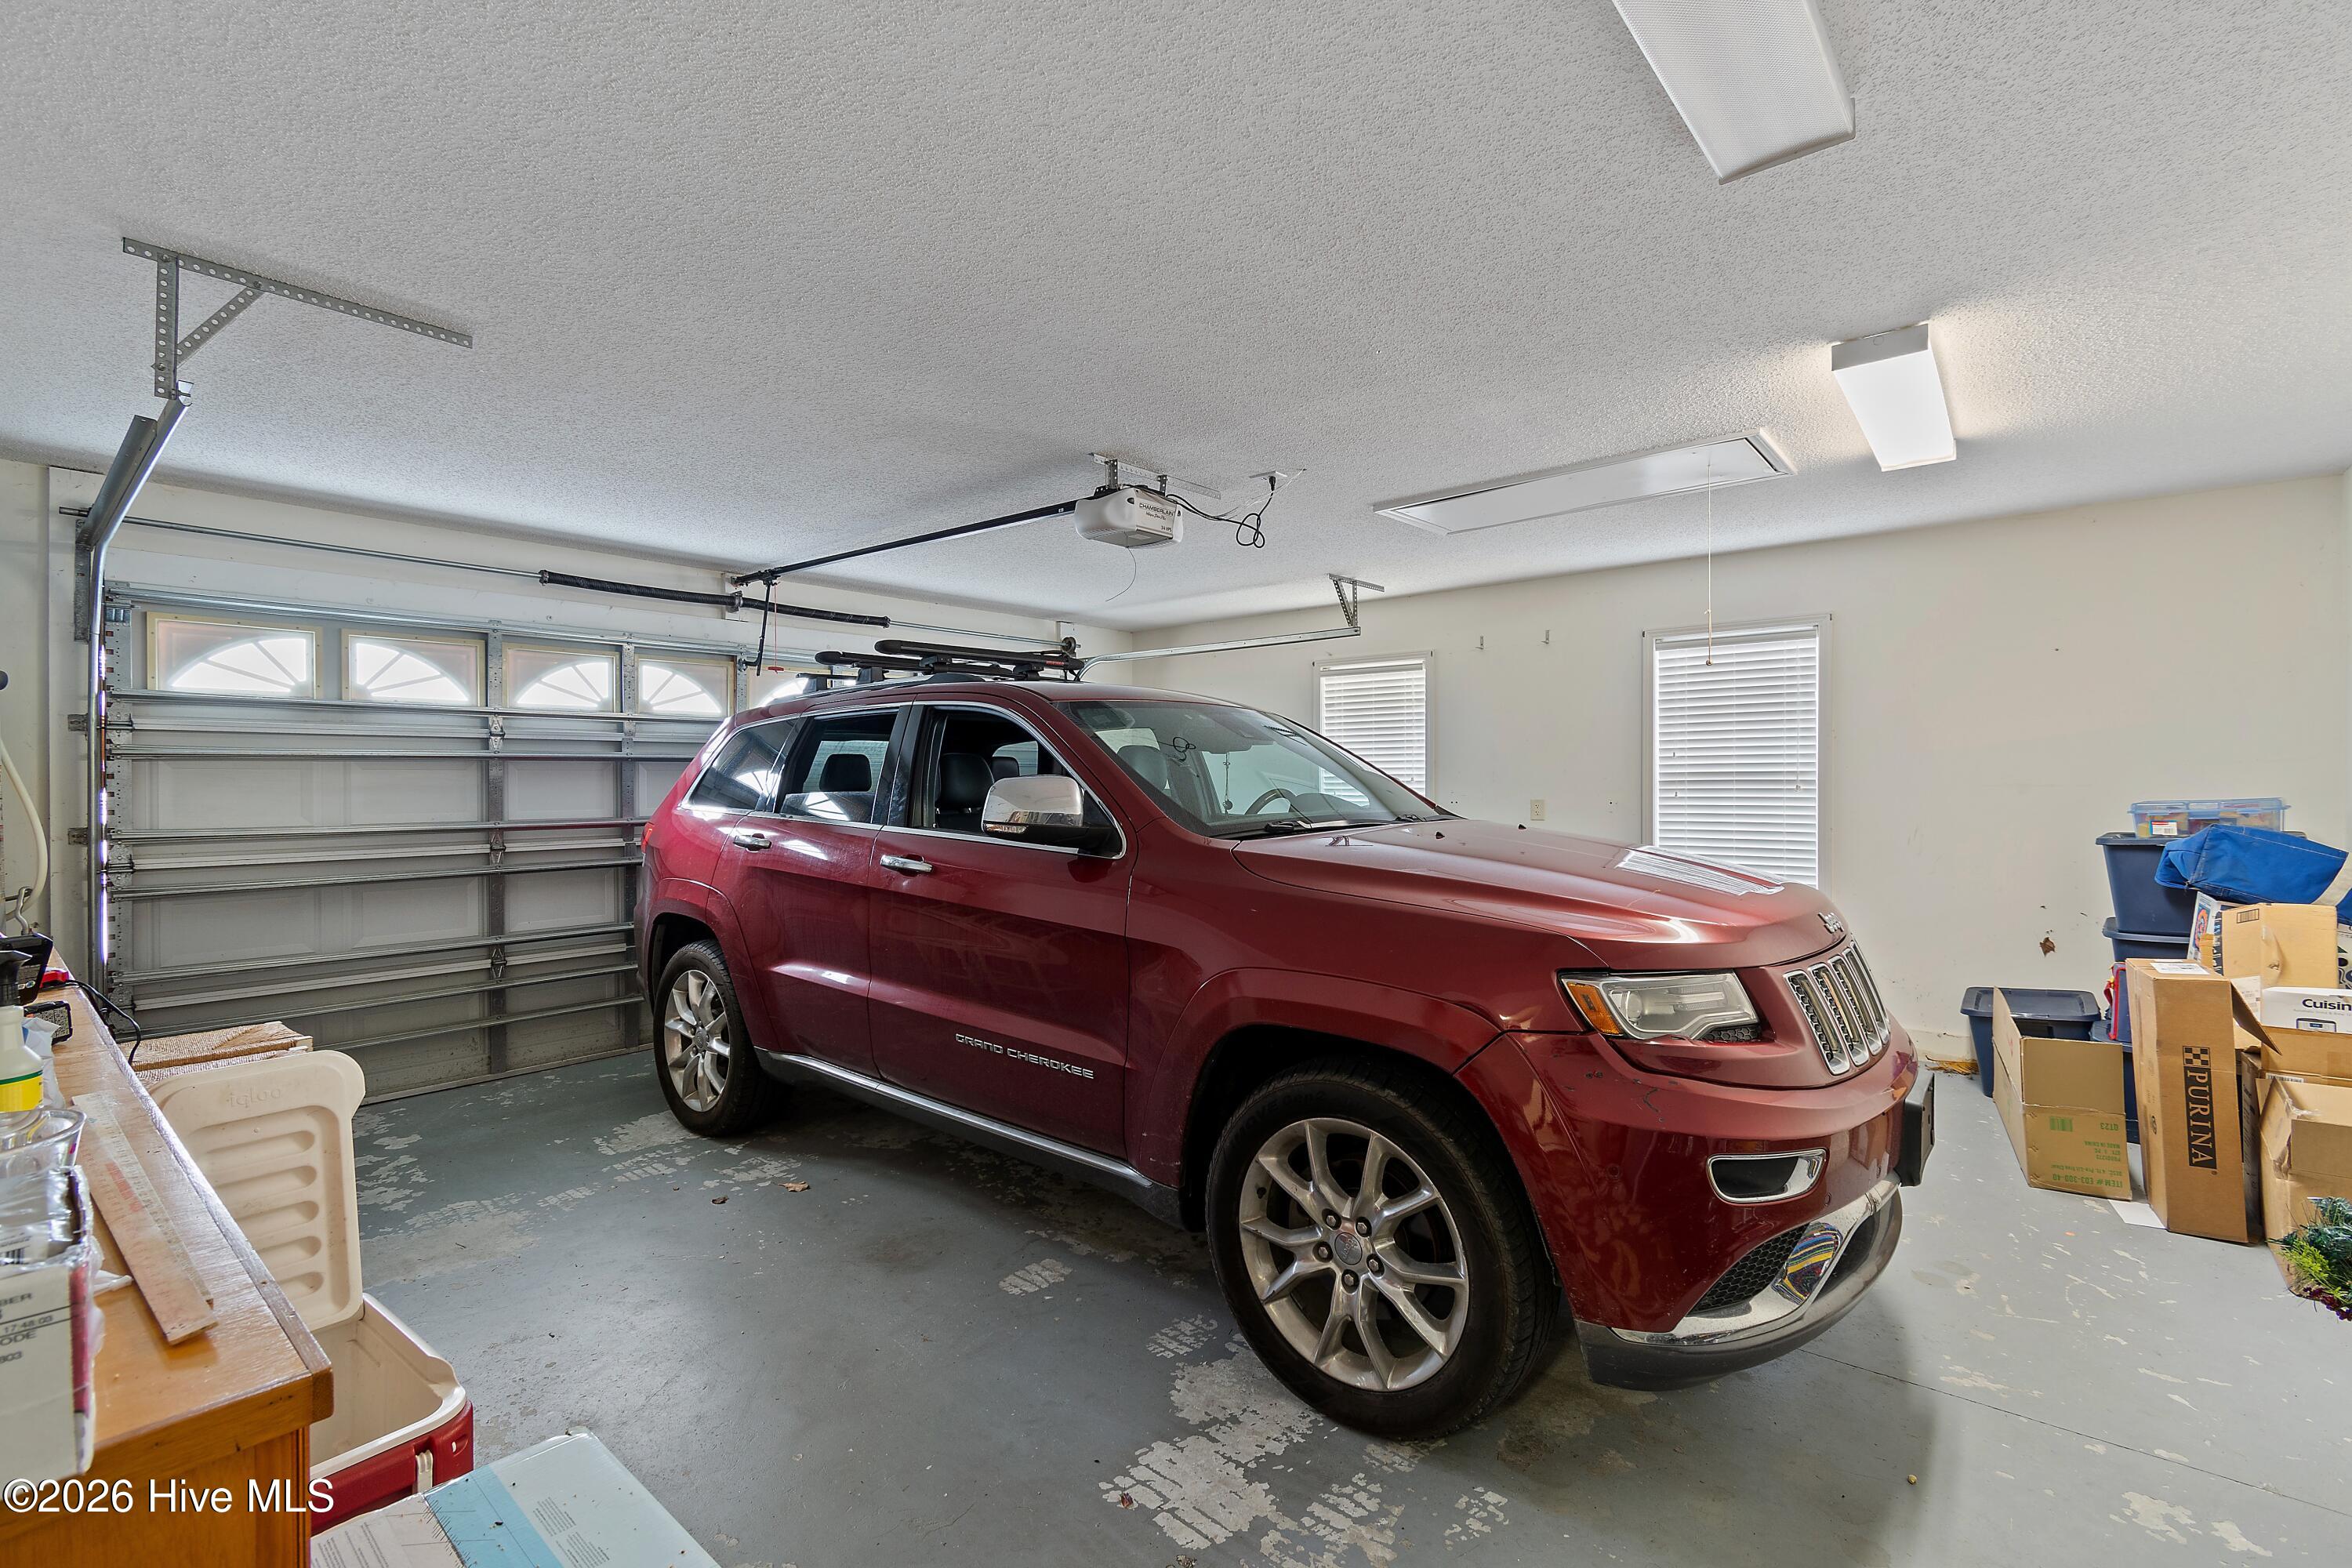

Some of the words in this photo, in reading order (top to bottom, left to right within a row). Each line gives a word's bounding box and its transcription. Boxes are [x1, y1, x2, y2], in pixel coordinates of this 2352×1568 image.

[1139, 503, 1174, 517] CHAMBERLAIN
[2302, 998, 2352, 1011] Cuisin
[956, 1033, 1004, 1054] GRAND
[1007, 1047, 1094, 1080] CHEROKEE
[2187, 1069, 2214, 1164] PURINA
[2105, 1179, 2122, 1188] ITEM
